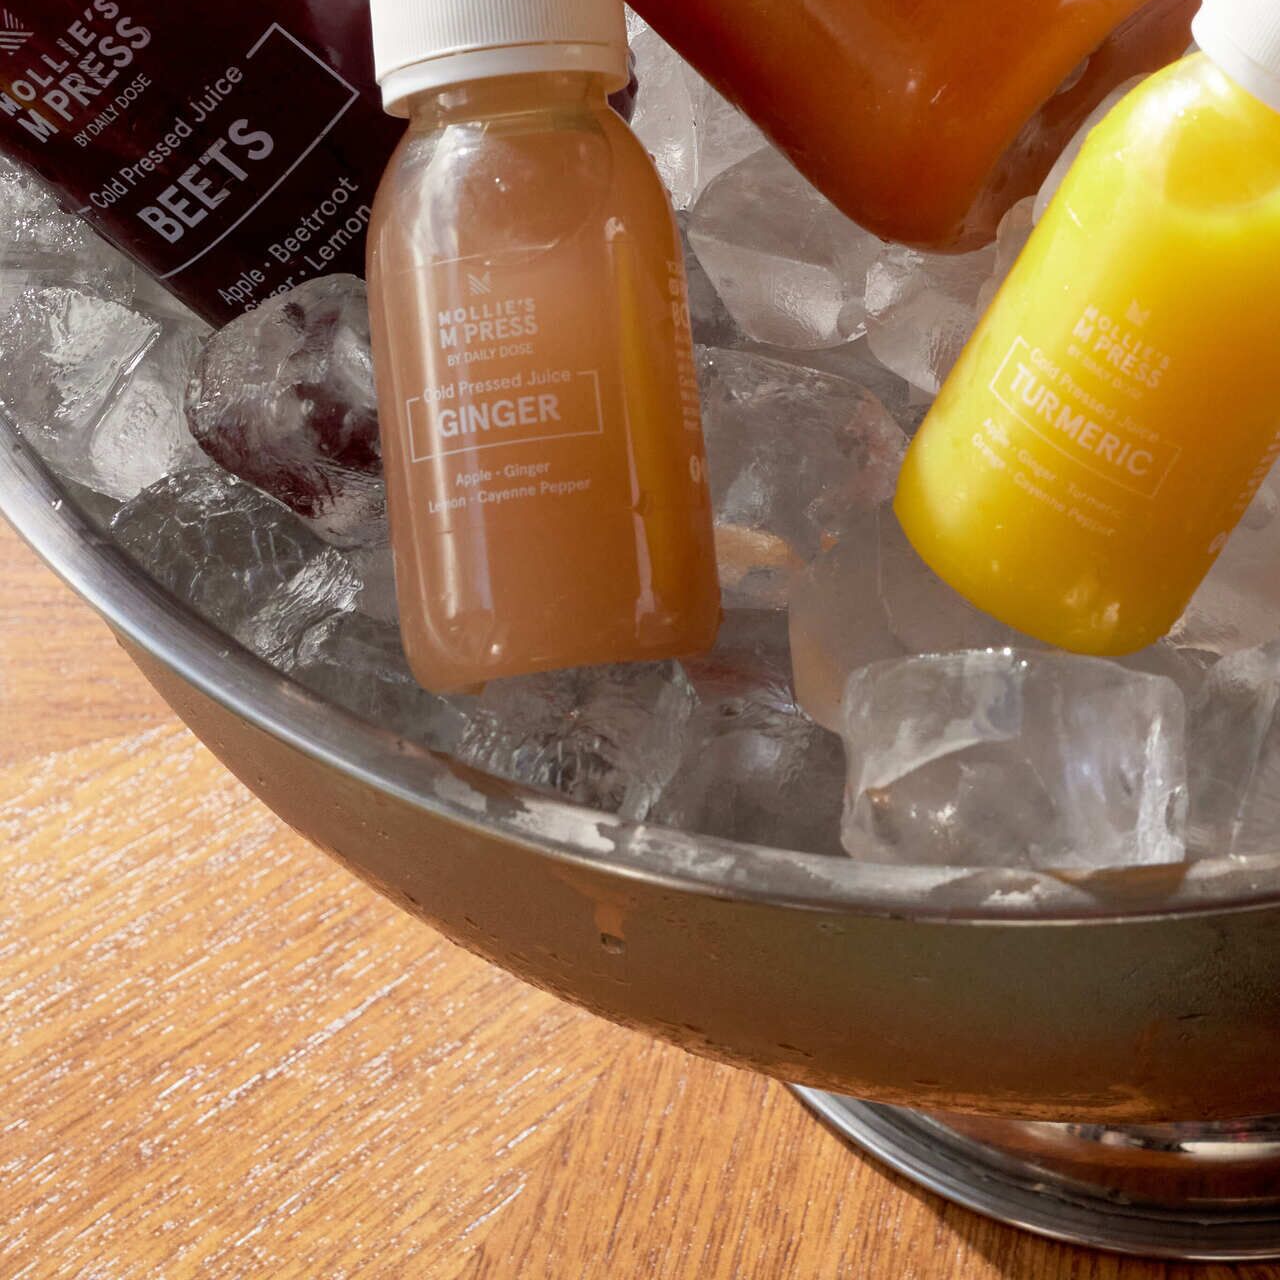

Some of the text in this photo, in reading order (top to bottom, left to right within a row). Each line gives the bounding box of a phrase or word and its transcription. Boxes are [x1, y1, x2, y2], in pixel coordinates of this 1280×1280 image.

[17, 16, 151, 143] M PRESS
[73, 72, 152, 148] BY DAILY DOSE
[89, 66, 243, 209] Cold Pressed Juice
[136, 118, 274, 245] BEETS
[217, 268, 266, 306] Apple
[268, 176, 359, 264] Beetroot
[304, 204, 373, 271] Lemon
[438, 297, 536, 326] MOLLIE'S
[439, 315, 539, 349] M PRESS
[1084, 304, 1172, 370] MOLLIE'S
[424, 368, 572, 404] Cold Pressed Juice
[447, 343, 534, 366] BY DAILY DOSE
[1029, 347, 1061, 381] Cold
[1059, 374, 1118, 422] Pressed
[1072, 316, 1162, 389] M PRESS
[437, 393, 562, 438] GINGER
[1010, 361, 1154, 477] TURMERIC
[428, 478, 592, 514] Lemon Cayenne Pepper
[455, 462, 551, 488] Apple Ginger
